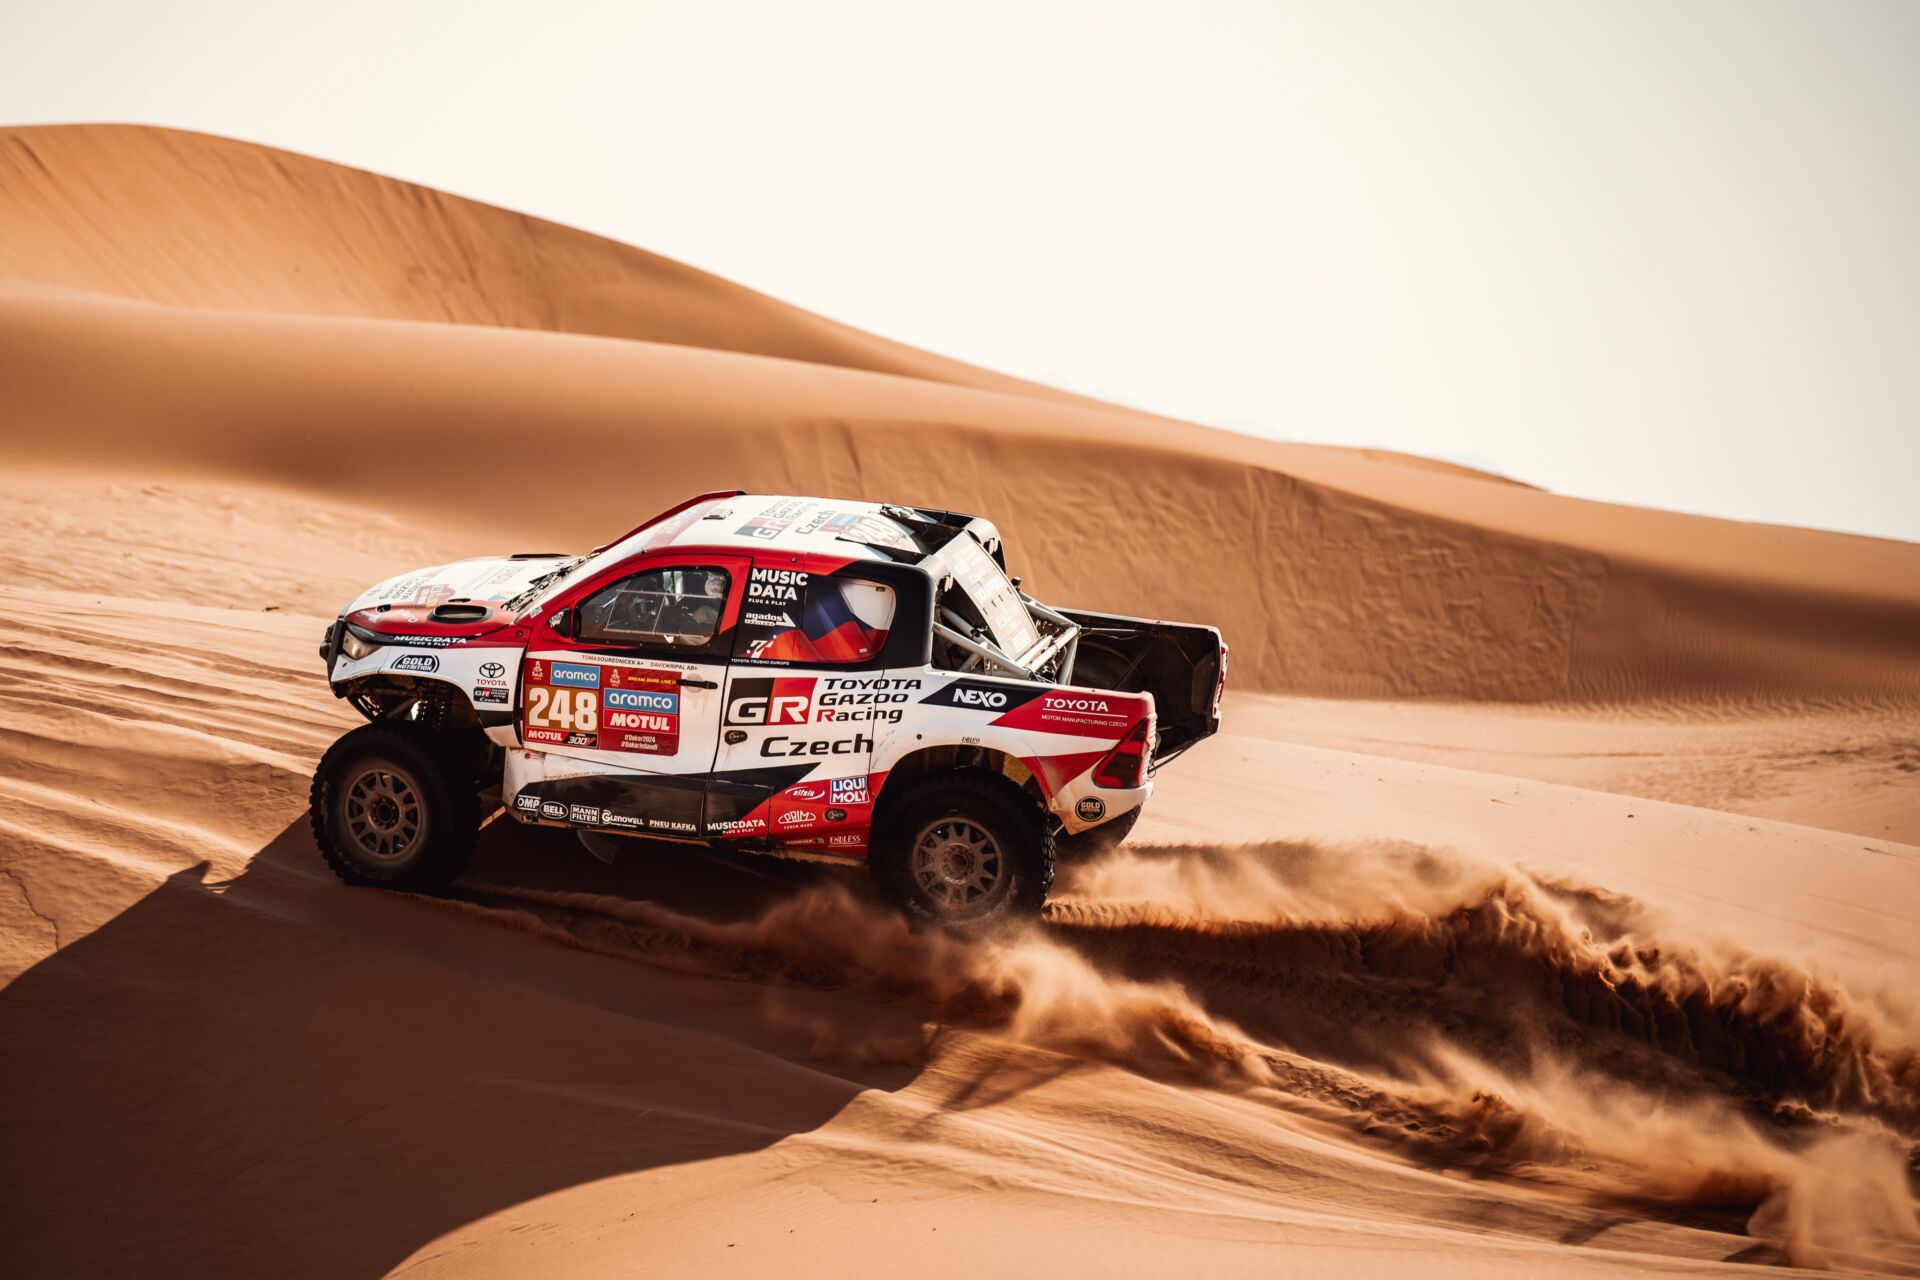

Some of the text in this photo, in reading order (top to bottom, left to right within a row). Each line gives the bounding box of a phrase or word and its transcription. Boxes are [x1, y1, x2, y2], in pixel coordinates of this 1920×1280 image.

[795, 510, 835, 535] Czech
[751, 568, 808, 586] MUSIC
[749, 583, 797, 600] DATA
[745, 612, 782, 621] agados
[394, 636, 467, 644] MUSICDATA
[396, 663, 433, 671] NUTRITION
[402, 657, 432, 666] GOLD
[554, 670, 597, 681] aramco
[476, 679, 507, 687] TOYOTA
[824, 678, 922, 690] TOYOTA
[609, 693, 672, 709] aramco
[819, 692, 909, 706] GAZOO
[952, 688, 1008, 707] NEXO
[529, 687, 597, 731] 248
[728, 696, 809, 724] GR
[1044, 697, 1109, 712] TOYOTA
[816, 707, 904, 724] Racing
[1041, 714, 1061, 722] MOTOR
[1062, 716, 1108, 726] MANUFACTURING
[610, 713, 670, 731] MOTUL
[528, 730, 563, 741] MOTUL
[567, 736, 596, 745] 300V
[624, 734, 656, 743] #Dakar2024
[760, 734, 874, 757] Czech
[832, 777, 865, 792] LIQUI
[832, 790, 866, 803] MOLY
[517, 797, 540, 809] OMP
[1081, 801, 1101, 809] GOLD
[543, 805, 564, 815] BELL
[572, 806, 597, 816] MANN
[783, 810, 810, 822] PRIM
[572, 813, 597, 822] FILTER
[649, 819, 670, 828] PNEU
[671, 821, 697, 831] KAFKA
[707, 819, 766, 831] MUSICDATA
[829, 835, 861, 843] ENDLESS
